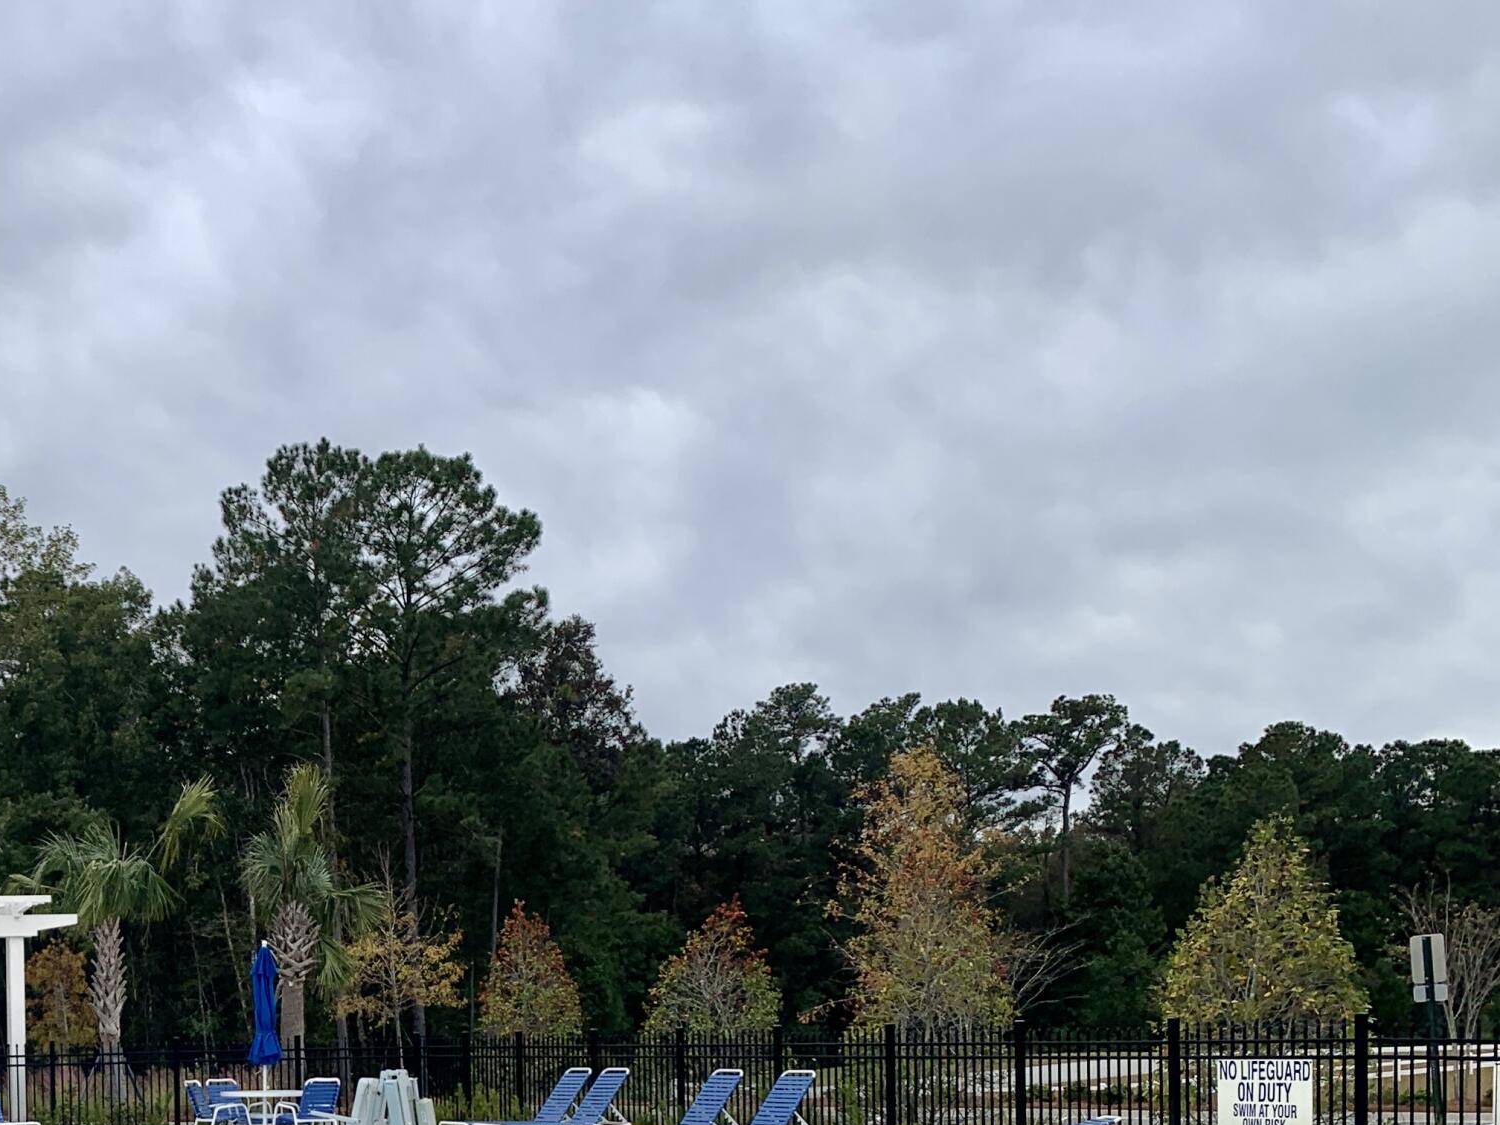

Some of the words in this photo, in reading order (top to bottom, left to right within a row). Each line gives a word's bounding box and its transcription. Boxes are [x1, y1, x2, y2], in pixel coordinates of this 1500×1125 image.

[1219, 1060, 1237, 1080] NO
[1240, 1060, 1310, 1081] LIFEGUARD
[1237, 1082, 1254, 1102] ON
[1258, 1082, 1292, 1103] DUTY
[1233, 1103, 1257, 1117] SWIM
[1258, 1104, 1270, 1118] AT
[1272, 1104, 1298, 1119] YOUR
